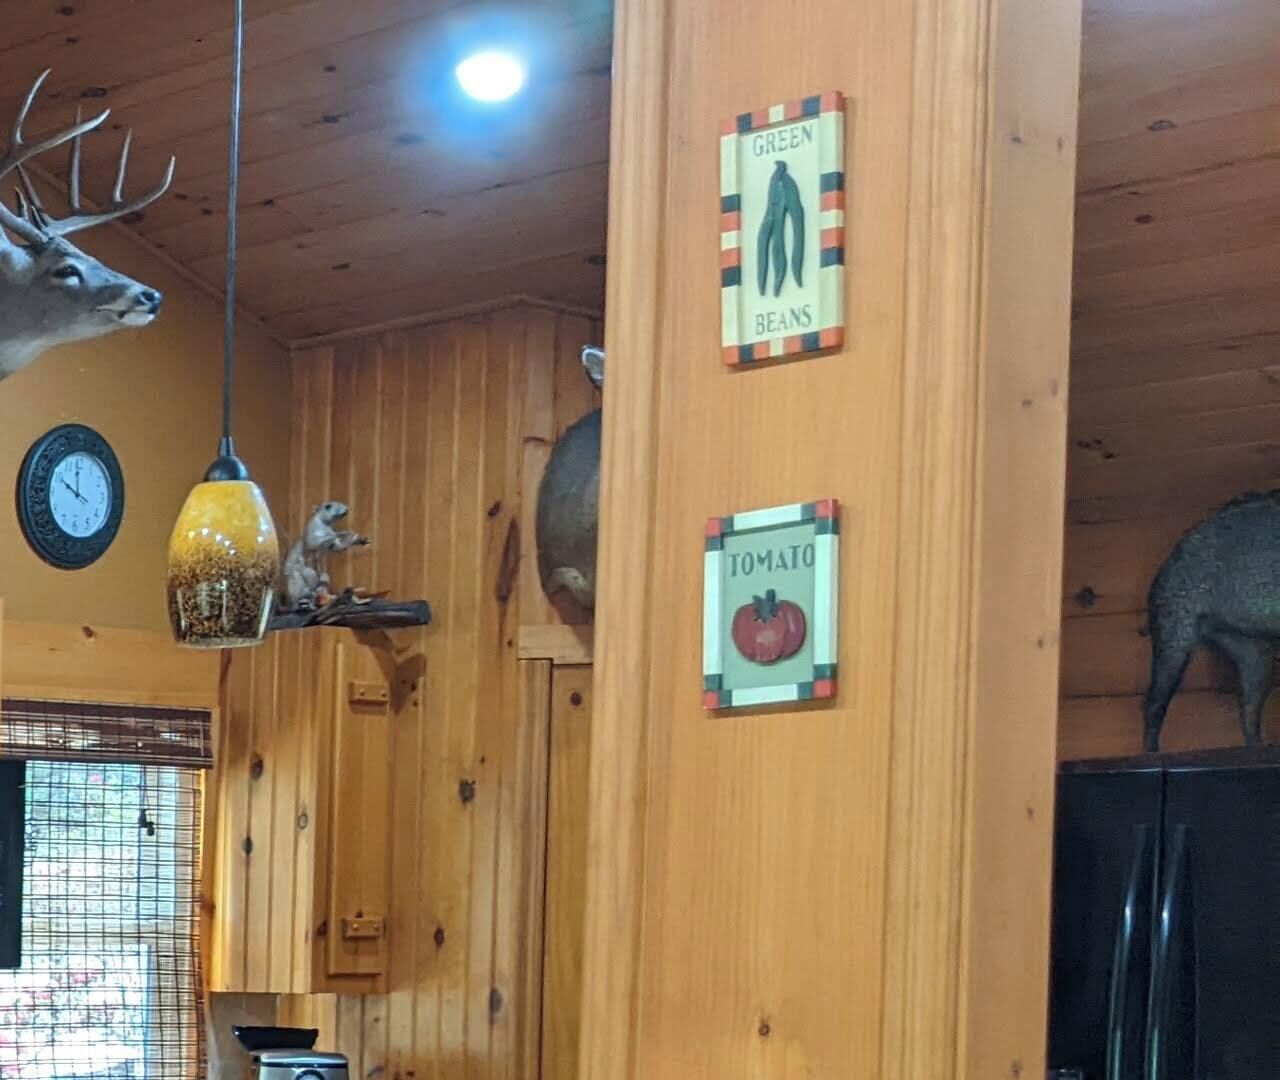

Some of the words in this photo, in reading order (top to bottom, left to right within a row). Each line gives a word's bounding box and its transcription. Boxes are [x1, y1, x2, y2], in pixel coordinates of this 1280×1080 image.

[753, 125, 813, 157] GREEN
[755, 304, 812, 335] BEANS
[728, 543, 816, 577] TOMATO
